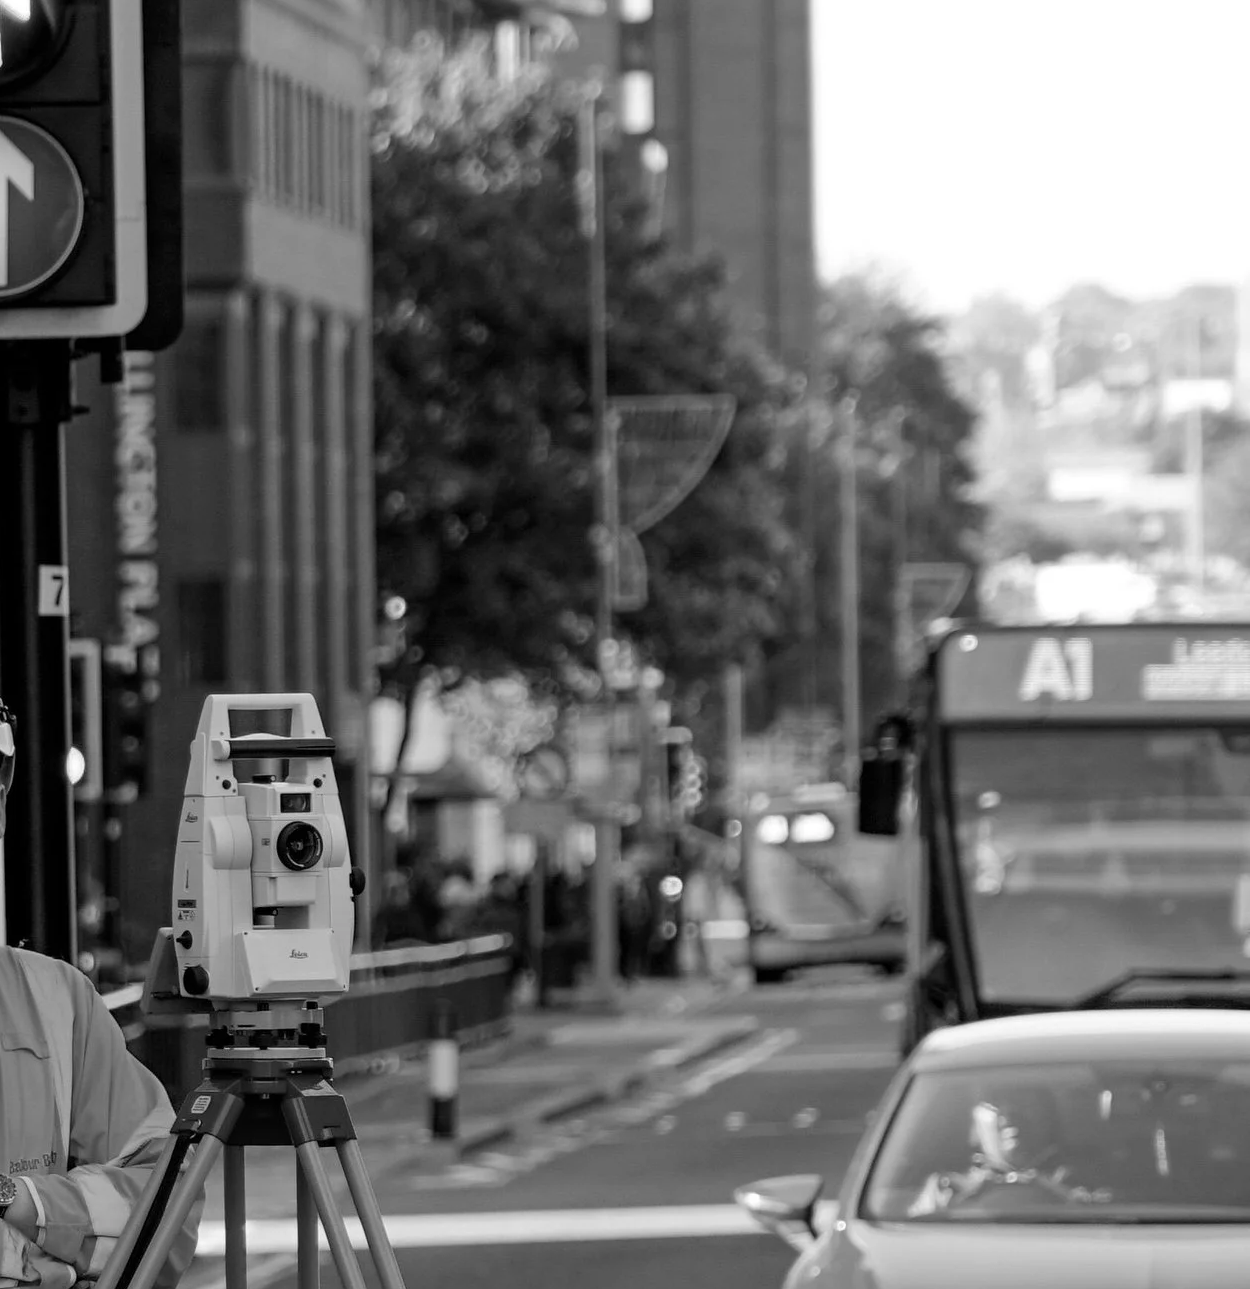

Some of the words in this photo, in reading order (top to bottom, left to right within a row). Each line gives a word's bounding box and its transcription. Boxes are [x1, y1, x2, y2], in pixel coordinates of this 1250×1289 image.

[52, 575, 64, 607] 7
[1018, 636, 1093, 702] A1
[289, 948, 308, 960] Leica
